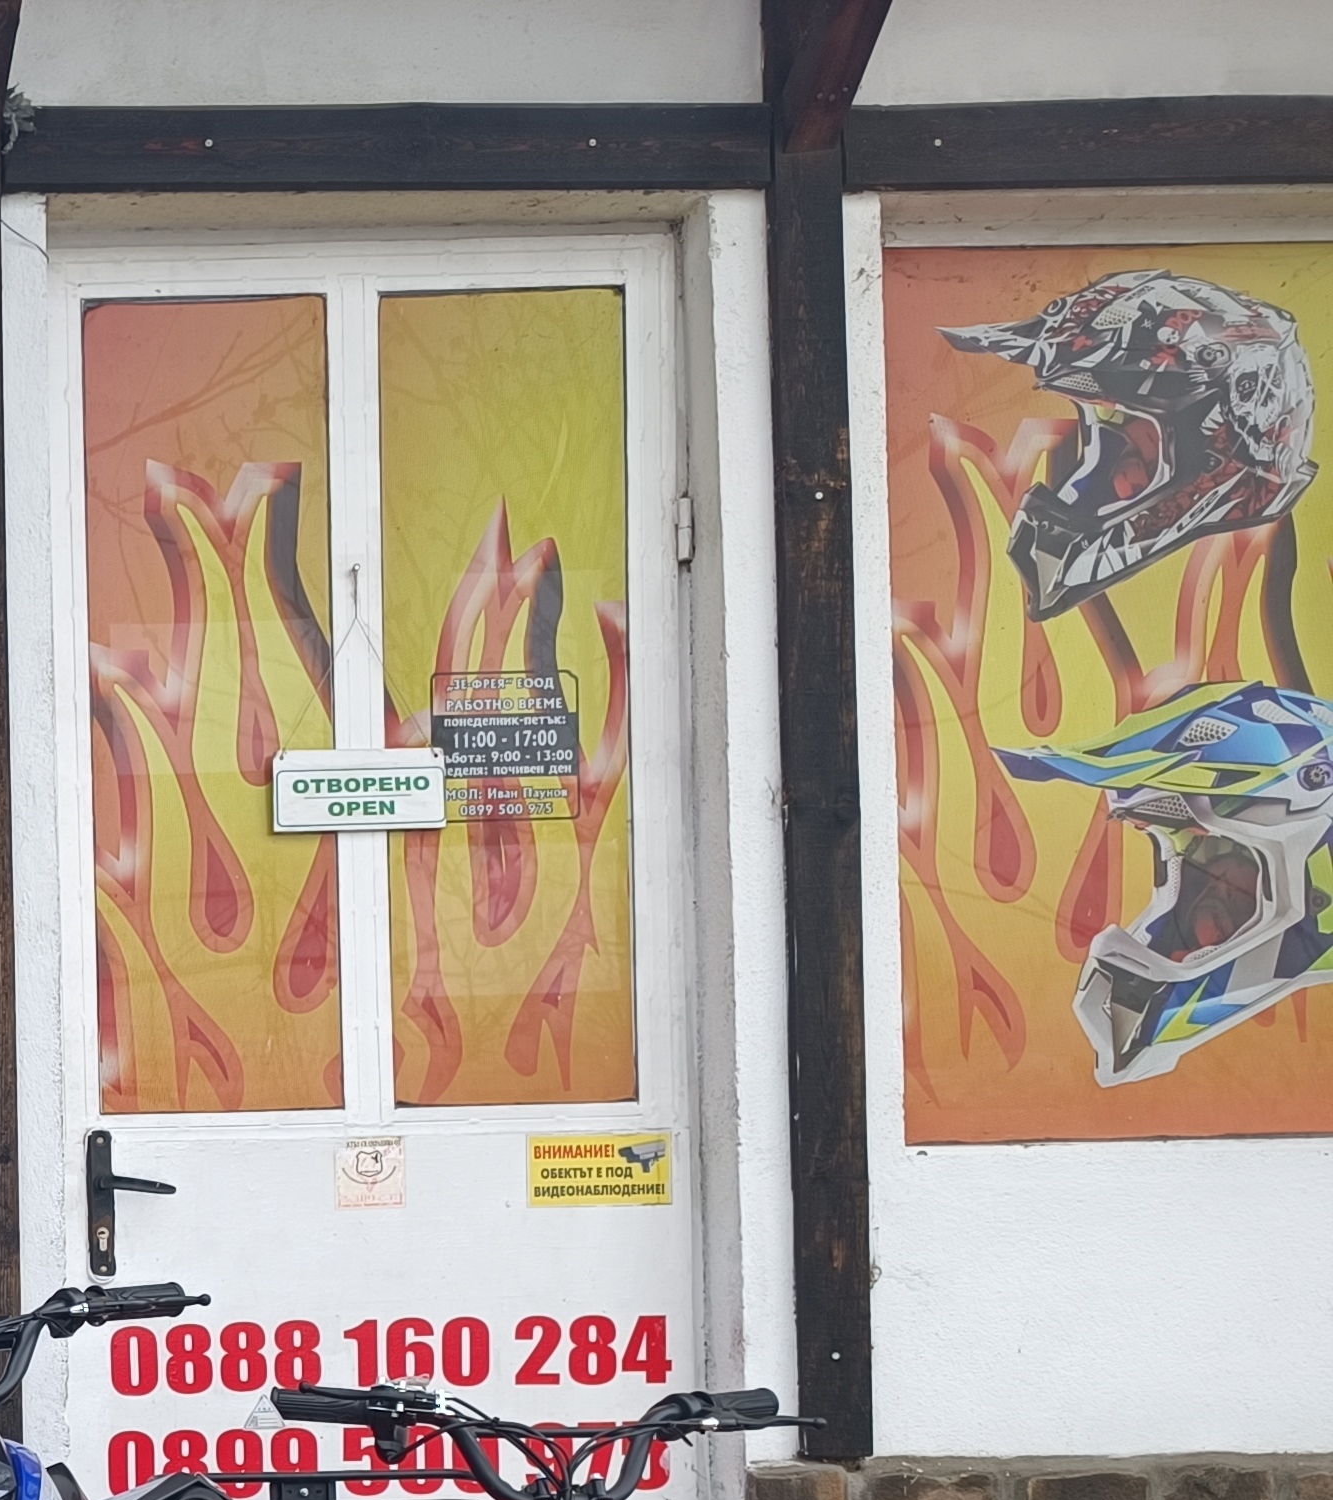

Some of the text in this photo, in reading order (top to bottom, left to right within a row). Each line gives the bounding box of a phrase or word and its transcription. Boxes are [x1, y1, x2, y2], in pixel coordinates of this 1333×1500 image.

[517, 677, 554, 690] ЕООД
[446, 697, 562, 712] РАБОТНО ВРЕМЕ
[444, 715, 566, 728] понеделник-петък:
[453, 730, 496, 749] 11:00
[514, 729, 558, 747] 17:00
[445, 752, 486, 764] ъбота:
[491, 750, 521, 763] 9:00
[536, 749, 573, 762] 13:00
[444, 763, 572, 777] еделя: почивен ден
[292, 776, 430, 794] ОТВОРЕНО
[445, 786, 568, 800] МОЛ: Иван Паунов
[328, 800, 395, 817] OPEN
[459, 802, 553, 816] 0899 500 975
[534, 1144, 615, 1159] ВНИМАНИЕ!
[540, 1166, 633, 1179] ОБЕКТЪТ Е ПОД
[534, 1183, 665, 1199] ВИДЕОНАБЛЮДЕНИЕ!
[110, 1315, 673, 1396] 0888 160 284
[108, 1428, 318, 1498] 0899
[343, 1425, 499, 1496] 500
